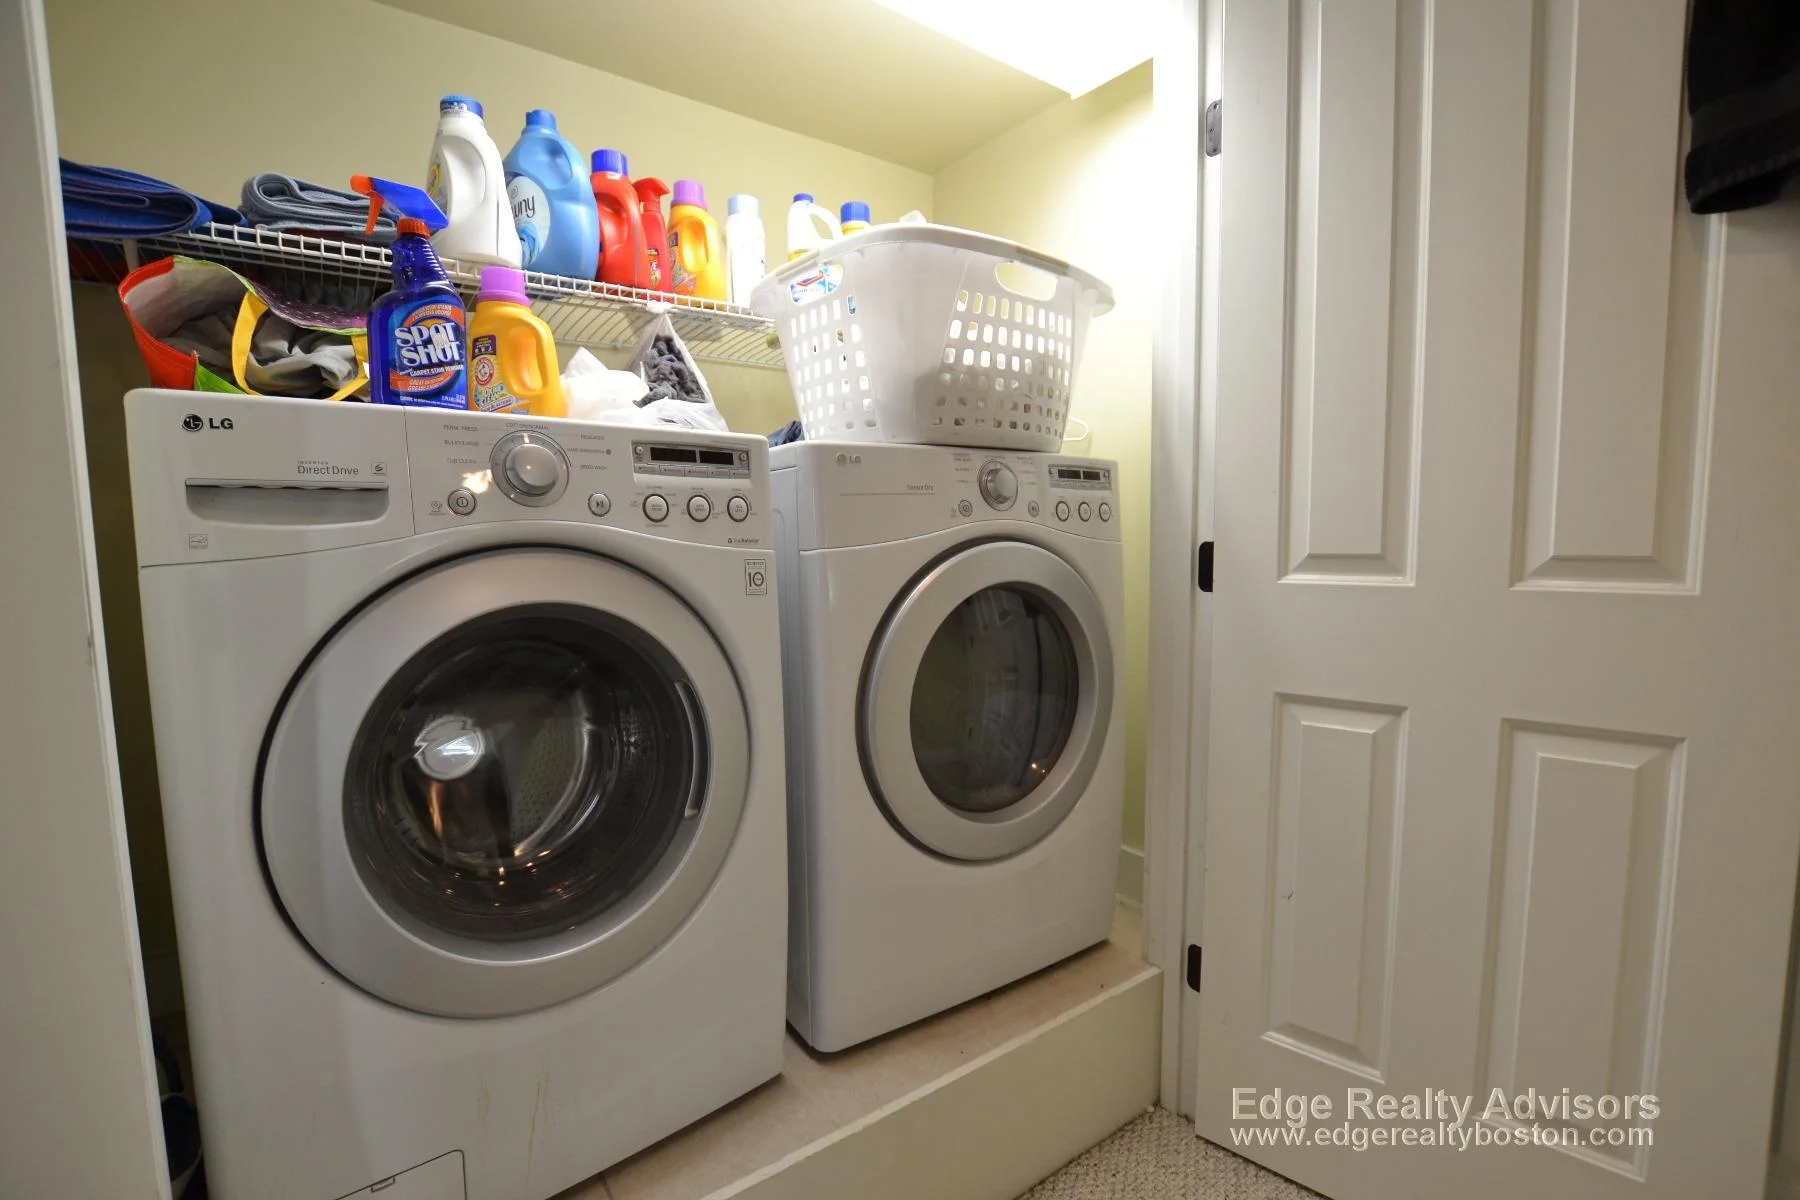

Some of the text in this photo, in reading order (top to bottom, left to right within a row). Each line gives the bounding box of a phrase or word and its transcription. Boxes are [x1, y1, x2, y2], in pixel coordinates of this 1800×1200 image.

[510, 196, 536, 219] wny
[394, 322, 455, 347] SPOT
[401, 341, 461, 367] SHOT
[409, 369, 430, 377] CARPET
[209, 417, 234, 430] LG
[297, 464, 359, 476] Direct Drive
